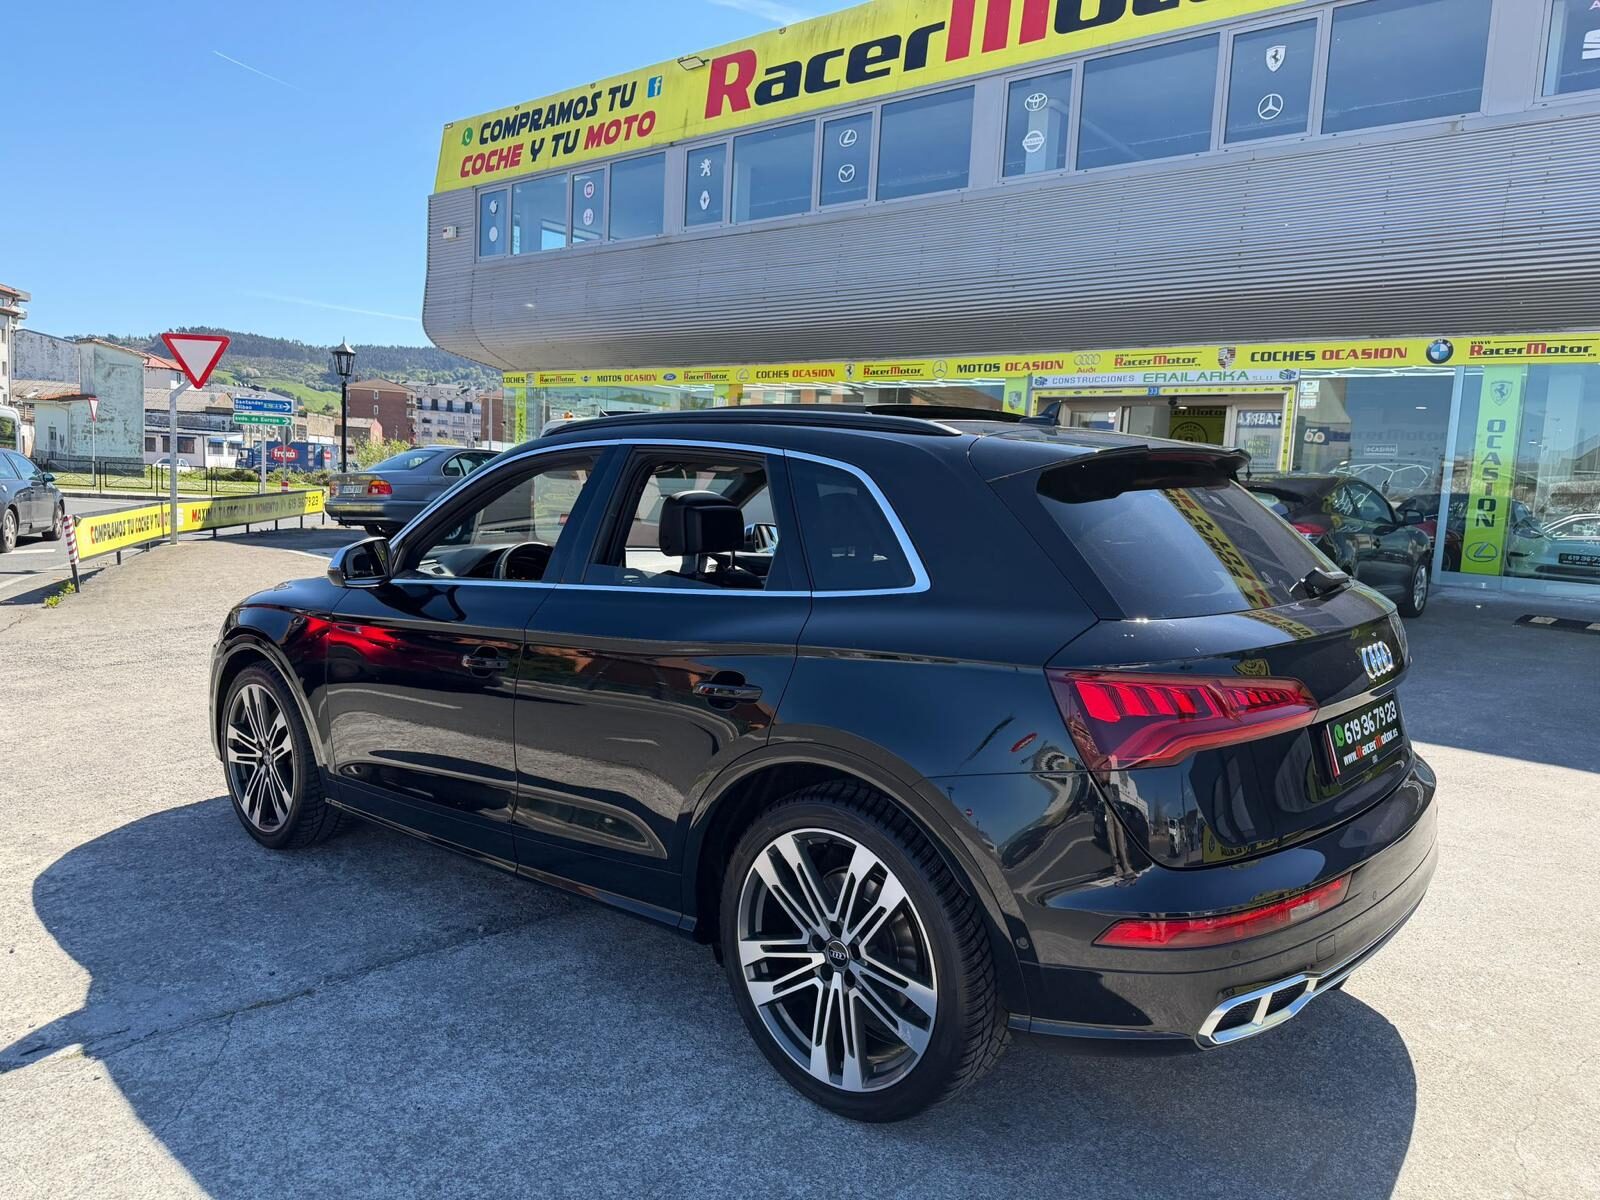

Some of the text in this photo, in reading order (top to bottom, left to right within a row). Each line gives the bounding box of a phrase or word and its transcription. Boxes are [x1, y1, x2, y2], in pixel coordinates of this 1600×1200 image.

[704, 0, 1208, 119] RacerMo
[479, 81, 637, 145] COMPRAMOS TU
[460, 110, 656, 178] COCHE Y TU MOTO
[1251, 347, 1407, 362] COCHES OCASION
[1470, 343, 1592, 356] RacerMotor
[956, 360, 1064, 373] MOTOS OCASION
[1114, 355, 1198, 367] RacerMotor
[624, 374, 657, 382] OCASION
[756, 368, 836, 379] COCHES OCASION
[863, 366, 922, 376] RacerMotor
[1052, 374, 1135, 385] CONSTRUCCIONES
[1143, 370, 1249, 383] ERAILARKA
[502, 376, 525, 384] COCHES
[1476, 419, 1506, 528] OCASION
[90, 519, 126, 545] COMPRAMOS
[135, 515, 149, 534] COCHE
[1344, 700, 1397, 745] 619 36 79 23
